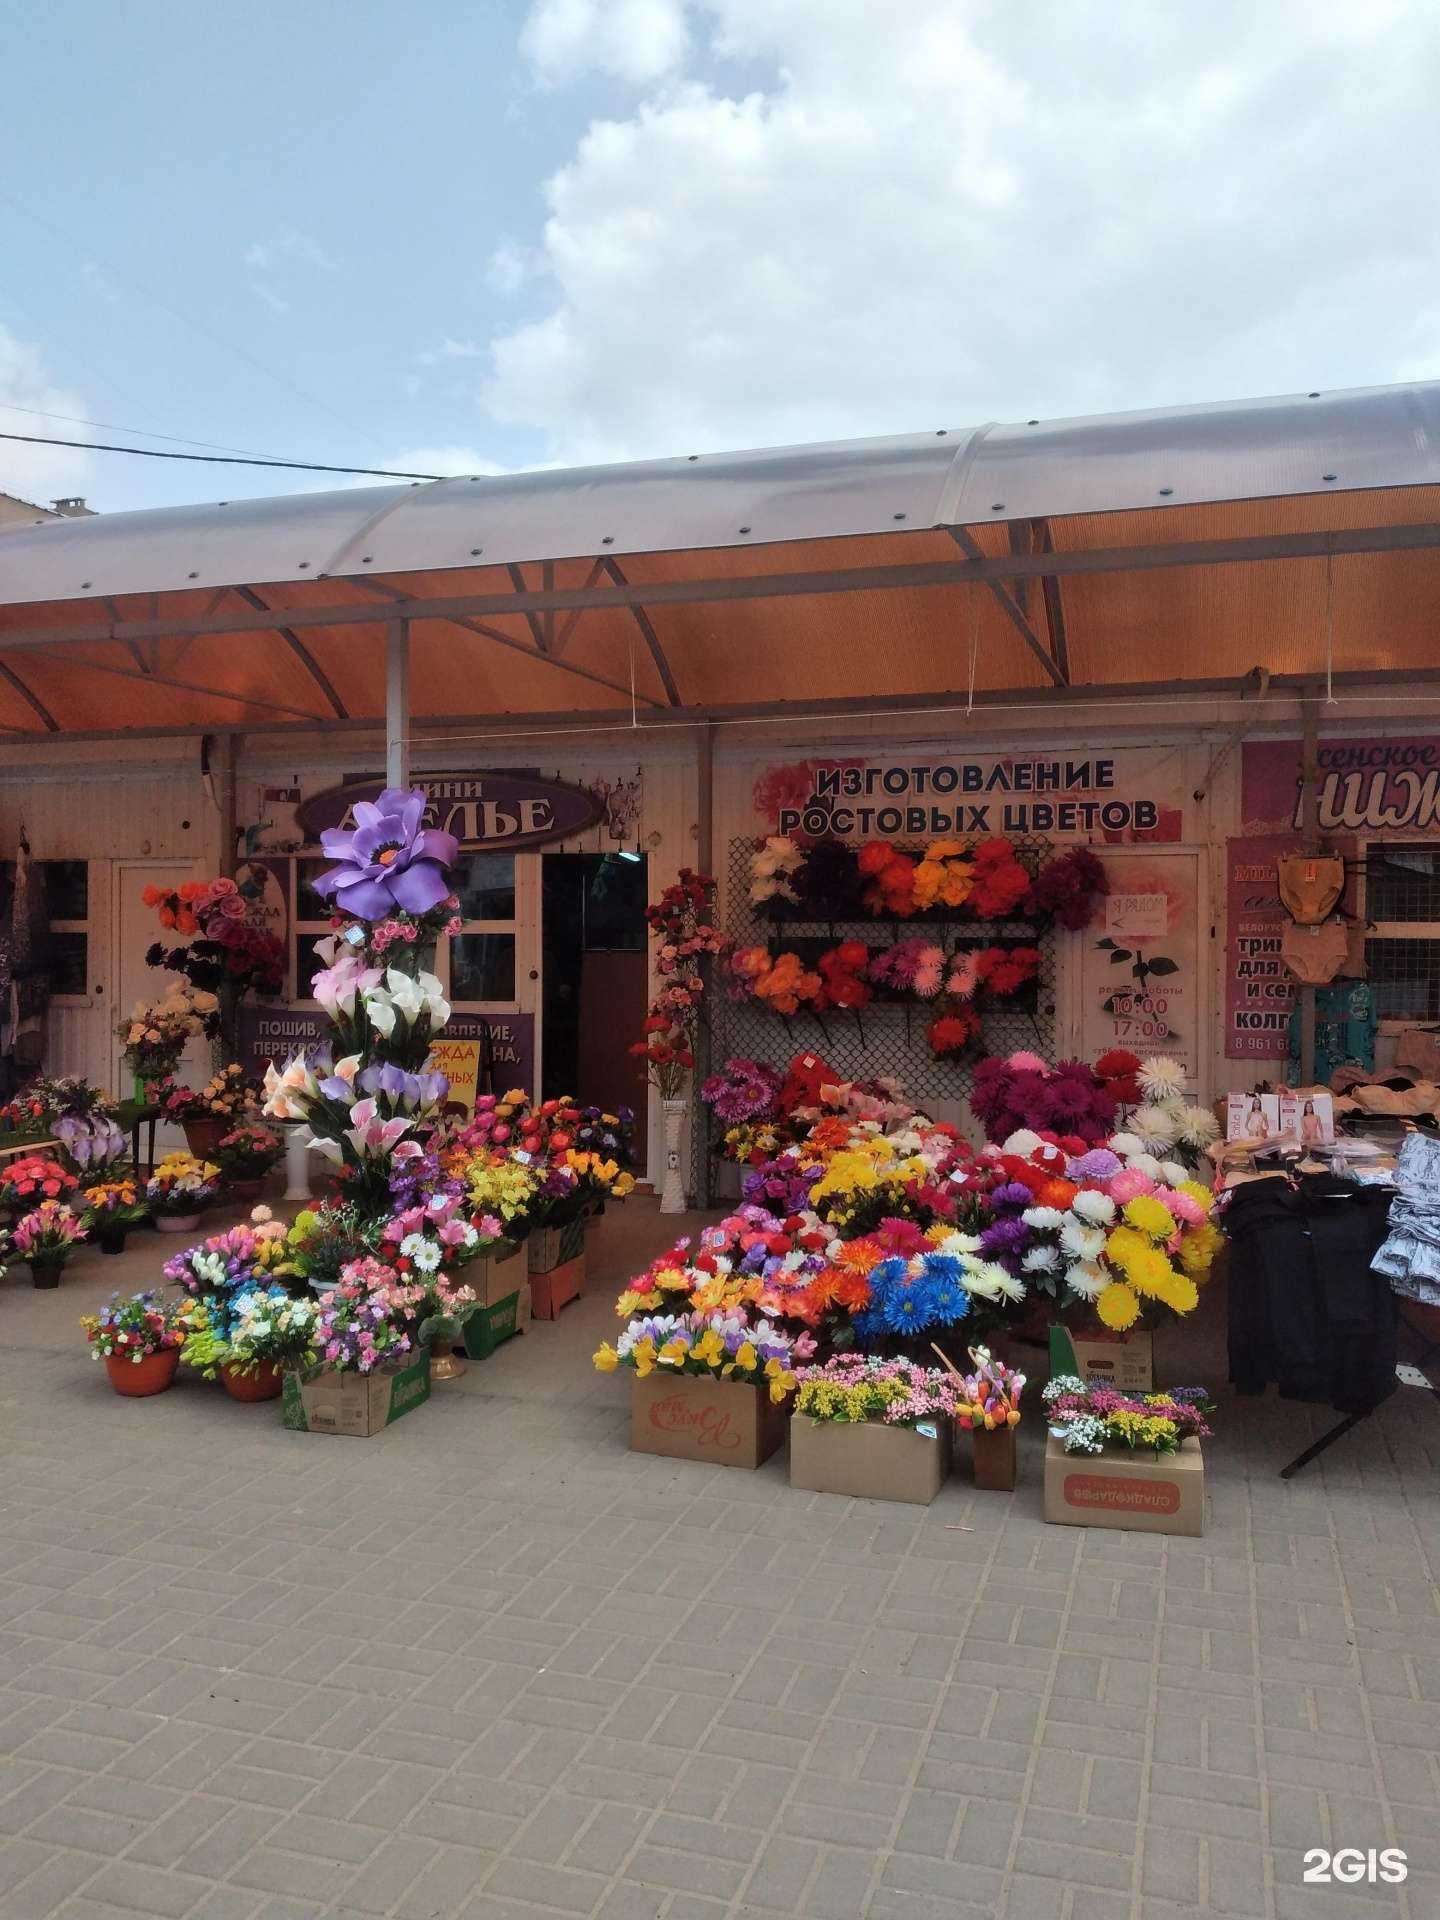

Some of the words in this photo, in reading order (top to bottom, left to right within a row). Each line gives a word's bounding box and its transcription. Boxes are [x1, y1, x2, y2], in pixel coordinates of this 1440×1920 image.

[816, 760, 1115, 797] ИЗГОТОВЛЕНИЕ
[336, 798, 555, 840] АЕЛЬЕ
[779, 804, 991, 837] РОСТОВЫХ
[1003, 800, 1159, 835] ЦВЕТОВ
[1237, 961, 1279, 978] для
[1113, 998, 1168, 1014] 10:00
[258, 1020, 321, 1039] ПОШИВ,
[1113, 1021, 1168, 1036] 17:00
[1235, 1038, 1243, 1049] 8
[1248, 1038, 1272, 1049] 961
